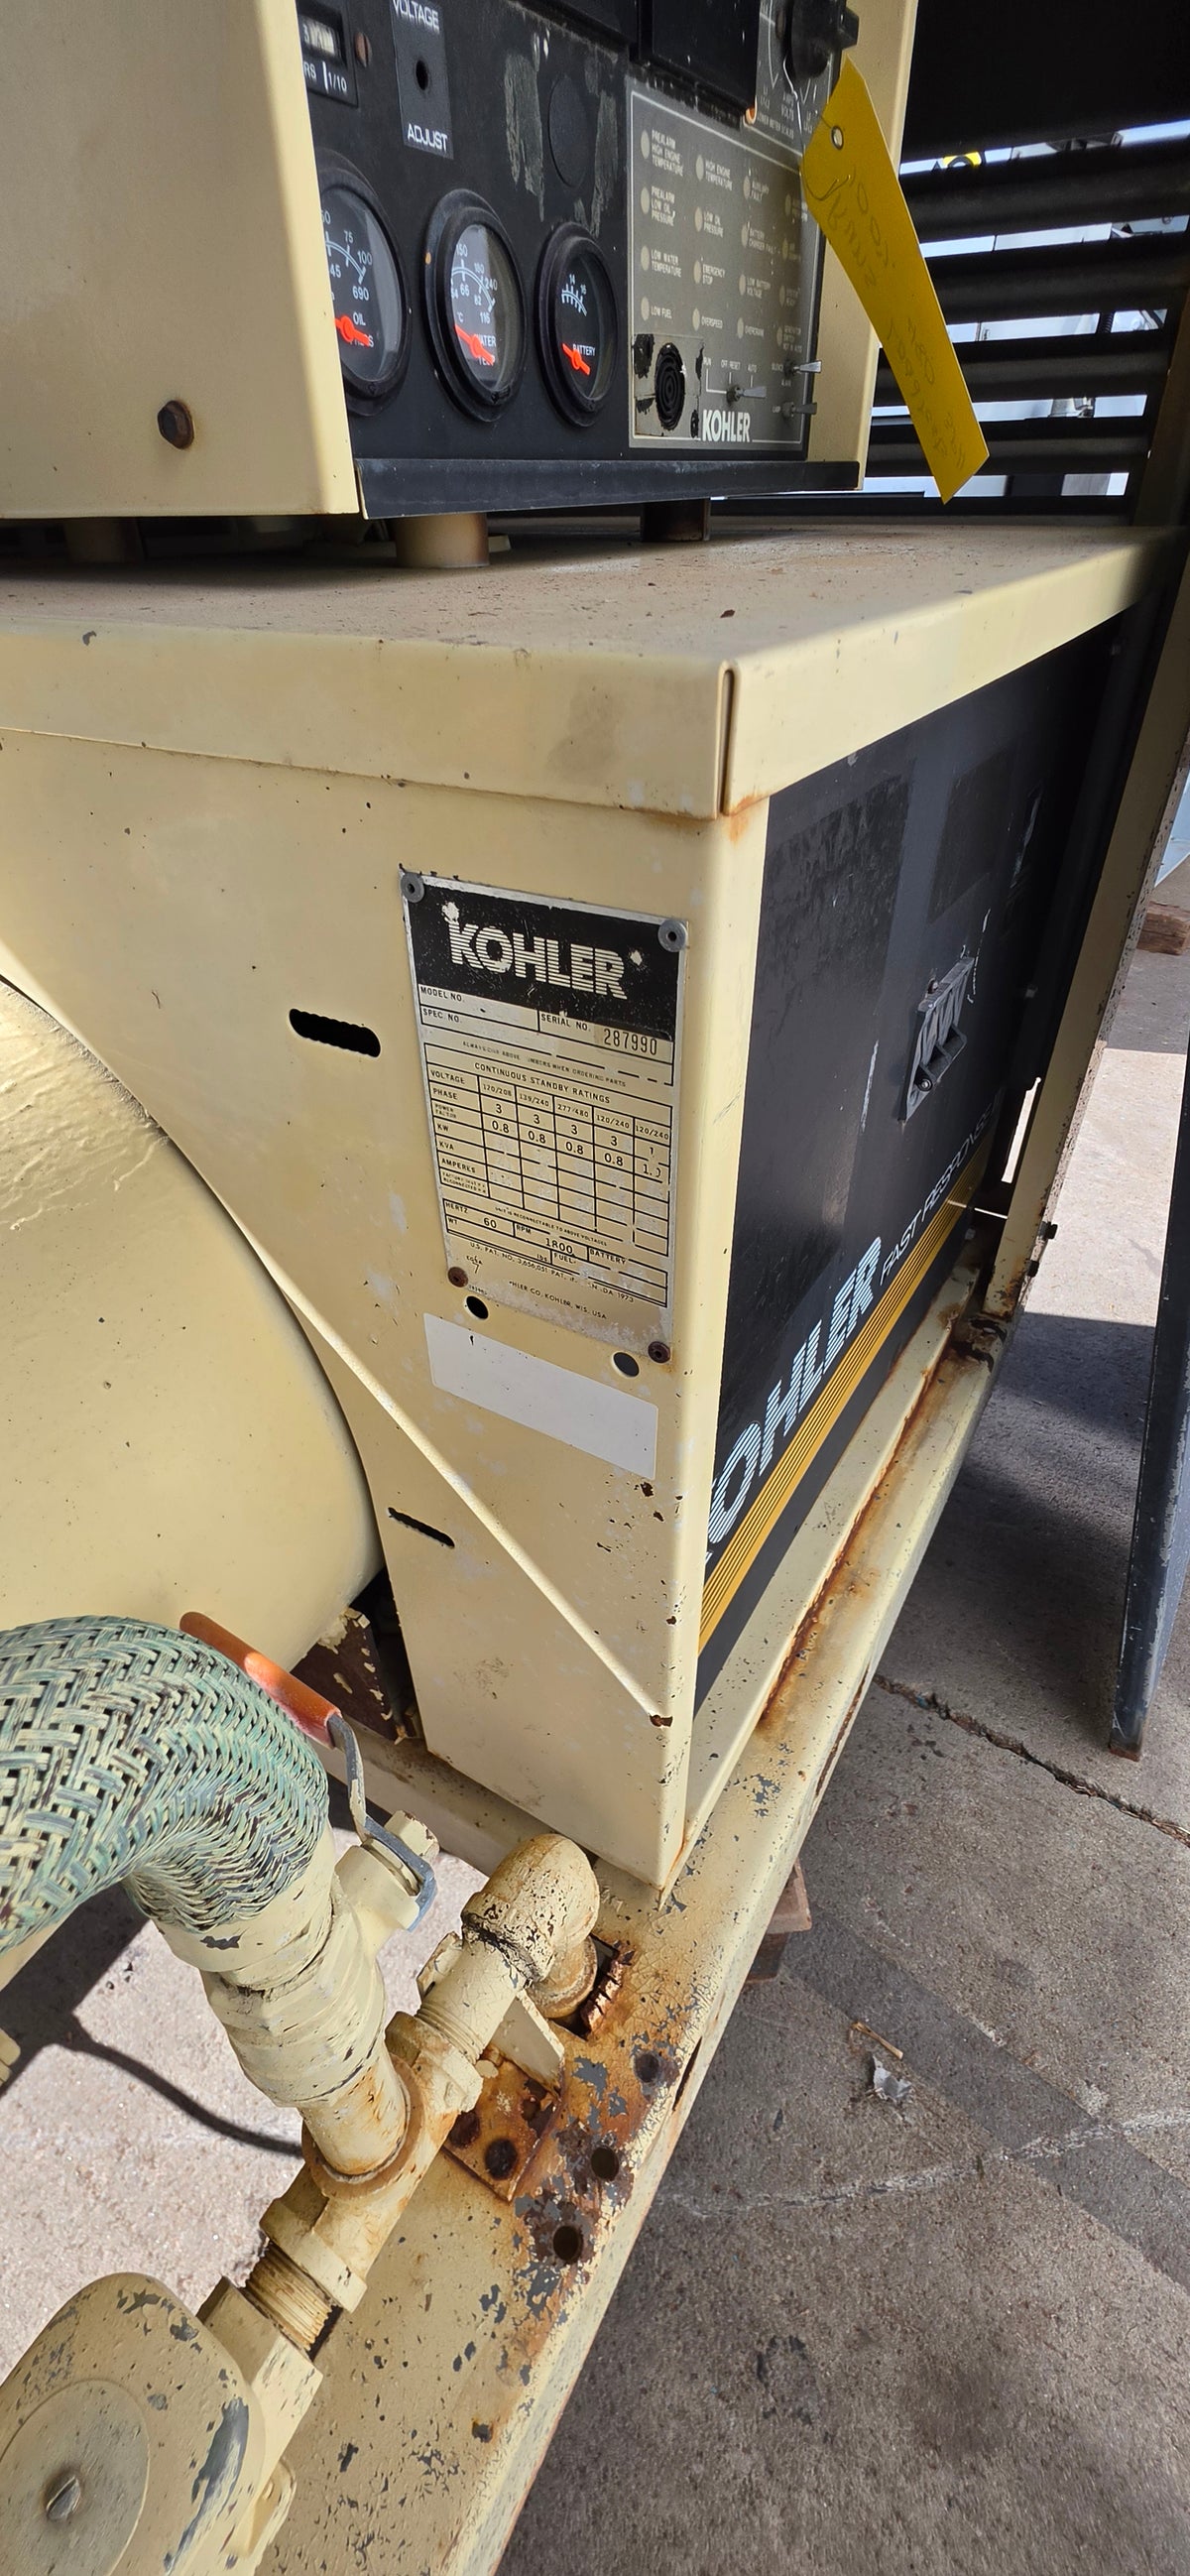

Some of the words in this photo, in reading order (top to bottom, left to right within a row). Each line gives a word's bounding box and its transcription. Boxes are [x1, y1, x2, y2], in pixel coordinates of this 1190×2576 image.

[393, 0, 440, 34] VOLTAGE
[770, 118, 780, 132] METER
[408, 124, 448, 153] ADJUST
[652, 129, 675, 150] PREALARM
[652, 143, 663, 156] HIGH
[664, 147, 680, 165] ENGINE
[652, 154, 683, 177] TEMPERATURE
[705, 160, 716, 171] HIGH
[716, 164, 731, 179] ENGINE
[705, 171, 733, 191] TEMPERATURE
[652, 185, 675, 204] PREALARM
[652, 197, 661, 211] LOW
[652, 210, 674, 227] PRESSURE
[704, 210, 713, 222] LOW
[343, 229, 354, 244] 75
[704, 222, 724, 239] PRESSURE
[357, 249, 373, 266] 100
[456, 244, 468, 258] 150
[651, 249, 661, 260] LOW
[663, 252, 679, 267] WATER
[329, 264, 341, 279] 45
[652, 261, 682, 278] TEMPERATURE
[702, 264, 726, 279] EMERGENCY
[484, 279, 498, 292] 240
[569, 273, 576, 285] 14
[702, 275, 714, 285] STOP
[352, 285, 370, 302] 690
[459, 284, 470, 298] 66
[474, 294, 482, 307] 82
[353, 310, 367, 326] OIL
[651, 306, 660, 316] LOW
[661, 308, 672, 319] FUEL
[701, 315, 723, 329] OVERSPEED
[476, 334, 497, 347] ATER
[572, 343, 597, 357] BATTERY
[703, 356, 712, 367] RUN
[748, 363, 758, 374] AUTO
[702, 408, 752, 443] KOHLER
[447, 921, 628, 1000] KOHLER
[420, 986, 449, 1001] MODEL
[450, 992, 465, 1003] NO.
[422, 1008, 443, 1020] SPEC
[447, 1013, 462, 1024] NO.
[540, 1013, 571, 1028] SERIAL
[576, 1021, 592, 1033] NO.
[603, 1028, 658, 1056] 287990
[502, 1050, 522, 1061] ABOVE
[552, 1061, 570, 1073] WHEN
[572, 1067, 604, 1081] ORDERING
[606, 1076, 627, 1088] PARTS
[474, 1061, 528, 1082] CONTINUOUS
[530, 1076, 569, 1093] STANDBY
[572, 1087, 611, 1104] RATINGS
[430, 1069, 465, 1084] VOLTAGE
[483, 1083, 513, 1097] 120/208
[519, 1093, 550, 1107] 139/240
[557, 1103, 589, 1118] 277/480
[596, 1114, 630, 1130] 120/240
[636, 1125, 669, 1141] 120/240
[432, 1087, 458, 1100] PHASE
[495, 1103, 503, 1114] 3
[533, 1114, 540, 1125] 3
[571, 1124, 578, 1135] 3
[610, 1135, 618, 1147] 3
[435, 1109, 457, 1119] FACTOR
[434, 1103, 454, 1113] POWER
[492, 1120, 510, 1134] 0.8
[528, 1130, 546, 1144] 0.8
[565, 1141, 584, 1155] 0.8
[604, 1153, 624, 1166] 0.8
[436, 1123, 449, 1132] KW
[438, 1141, 454, 1151] KVA
[441, 1157, 476, 1173] AMPERES
[448, 1217, 458, 1226] WT
[513, 1211, 555, 1230] RECONNECTABLE
[563, 1229, 580, 1238] ABOVE
[581, 1234, 608, 1247] VOLTAGES
[445, 1202, 468, 1214] HERTZ
[483, 1217, 497, 1229] 60
[516, 1223, 532, 1235] RPM
[544, 1237, 573, 1255] 1800
[589, 1248, 627, 1265] BATTERY
[470, 1242, 483, 1252] U.S.
[484, 1247, 500, 1257] PAT.
[502, 1253, 515, 1263] NO.
[550, 1270, 567, 1281] PAT.
[617, 1292, 635, 1303] 1973
[592, 1308, 607, 1320] USA
[705, 1236, 882, 1564] OHLER
[880, 1208, 922, 1287] FAST
